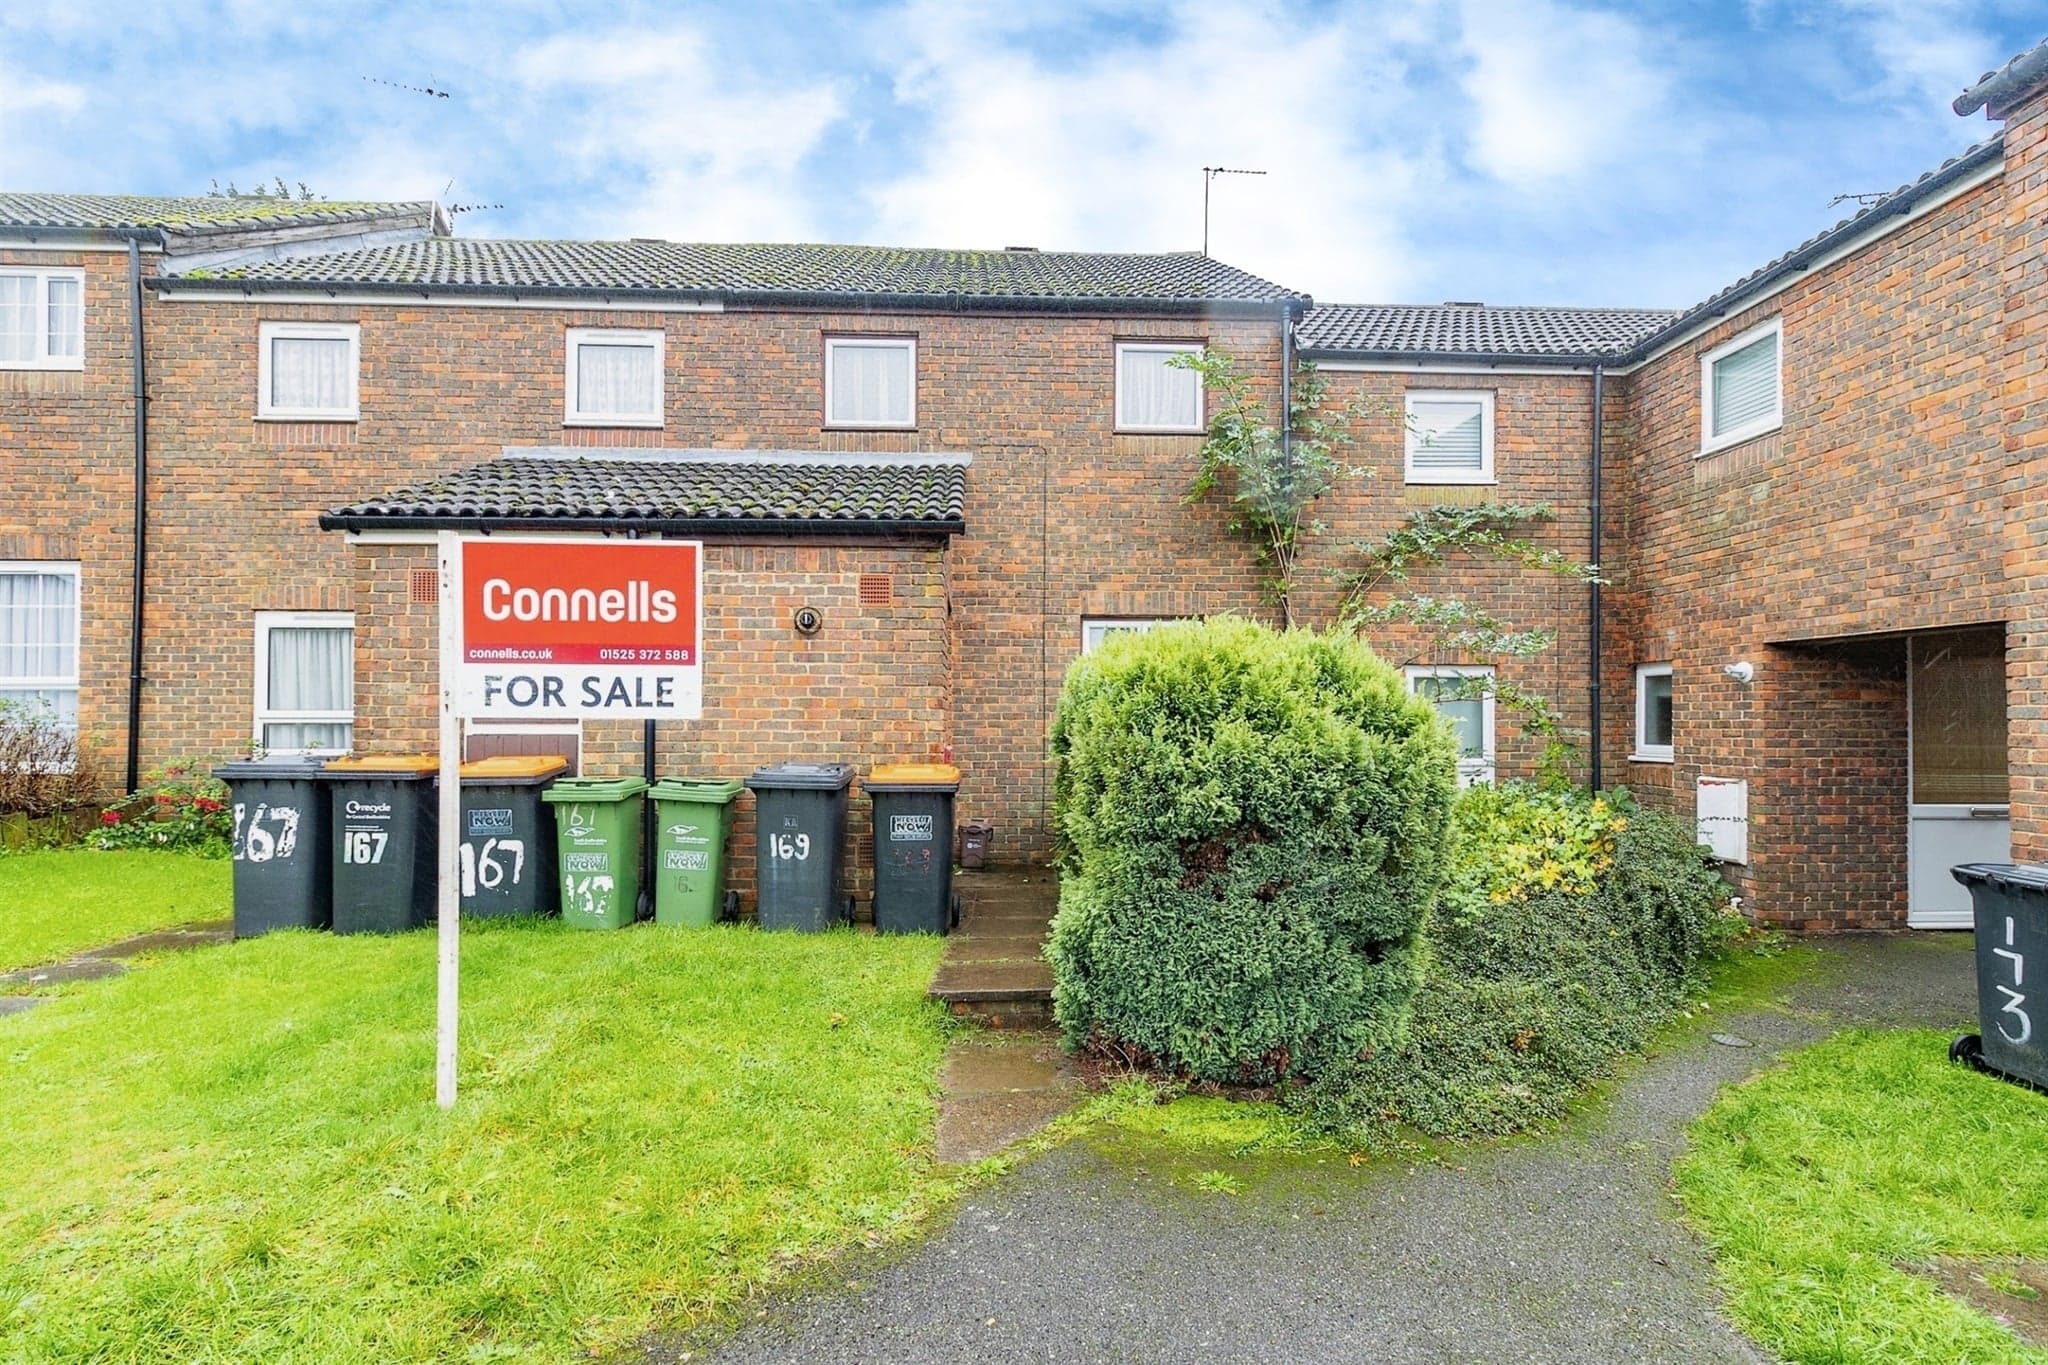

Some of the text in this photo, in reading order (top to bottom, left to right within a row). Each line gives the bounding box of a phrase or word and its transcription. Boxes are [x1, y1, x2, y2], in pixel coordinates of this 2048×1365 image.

[483, 578, 677, 623] Connells
[469, 648, 553, 660] connells.co.uk
[600, 649, 689, 661] 01525 372 588
[484, 675, 675, 708] FOR SALE
[344, 831, 389, 865] 167
[769, 832, 811, 861] 169
[459, 837, 525, 898] 167
[1993, 916, 2032, 1045] 173
